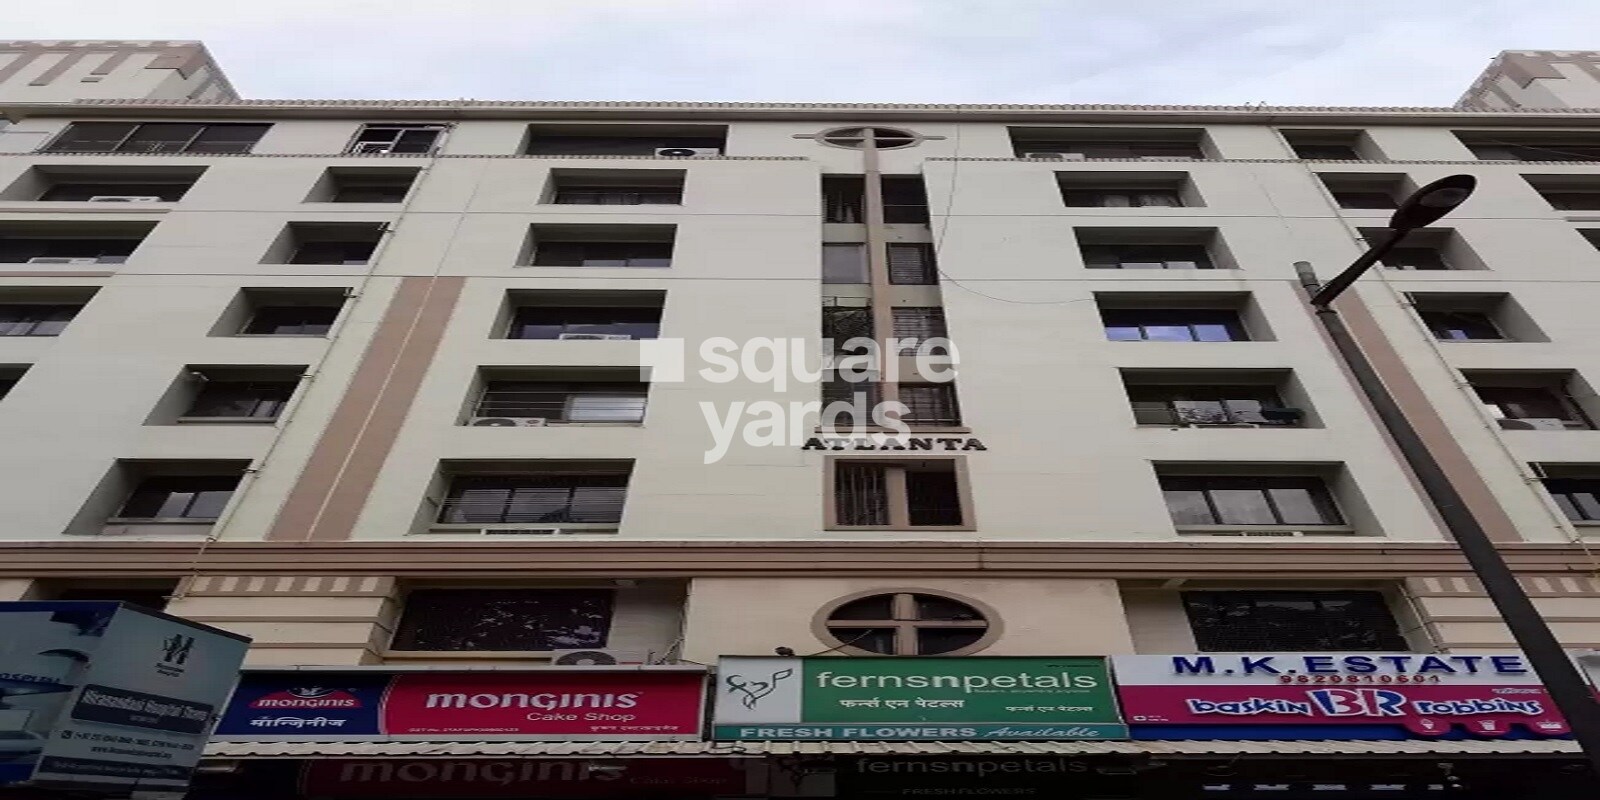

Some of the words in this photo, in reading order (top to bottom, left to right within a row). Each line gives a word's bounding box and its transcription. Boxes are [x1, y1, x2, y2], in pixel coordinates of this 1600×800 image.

[801, 437, 987, 450] ATLANTA
[816, 671, 1098, 693] fernsnpetals
[258, 699, 354, 708] monginis
[426, 693, 640, 710] monginis
[884, 700, 910, 709] एन
[1187, 698, 1312, 715] baskin
[1411, 698, 1544, 715] robbins
[526, 712, 578, 721] Cake
[584, 712, 636, 722] Shop
[740, 728, 833, 737] FRESH
[843, 728, 978, 737] FLOWERS
[984, 726, 1101, 737] Available
[856, 758, 1089, 778] fernsnpetals
